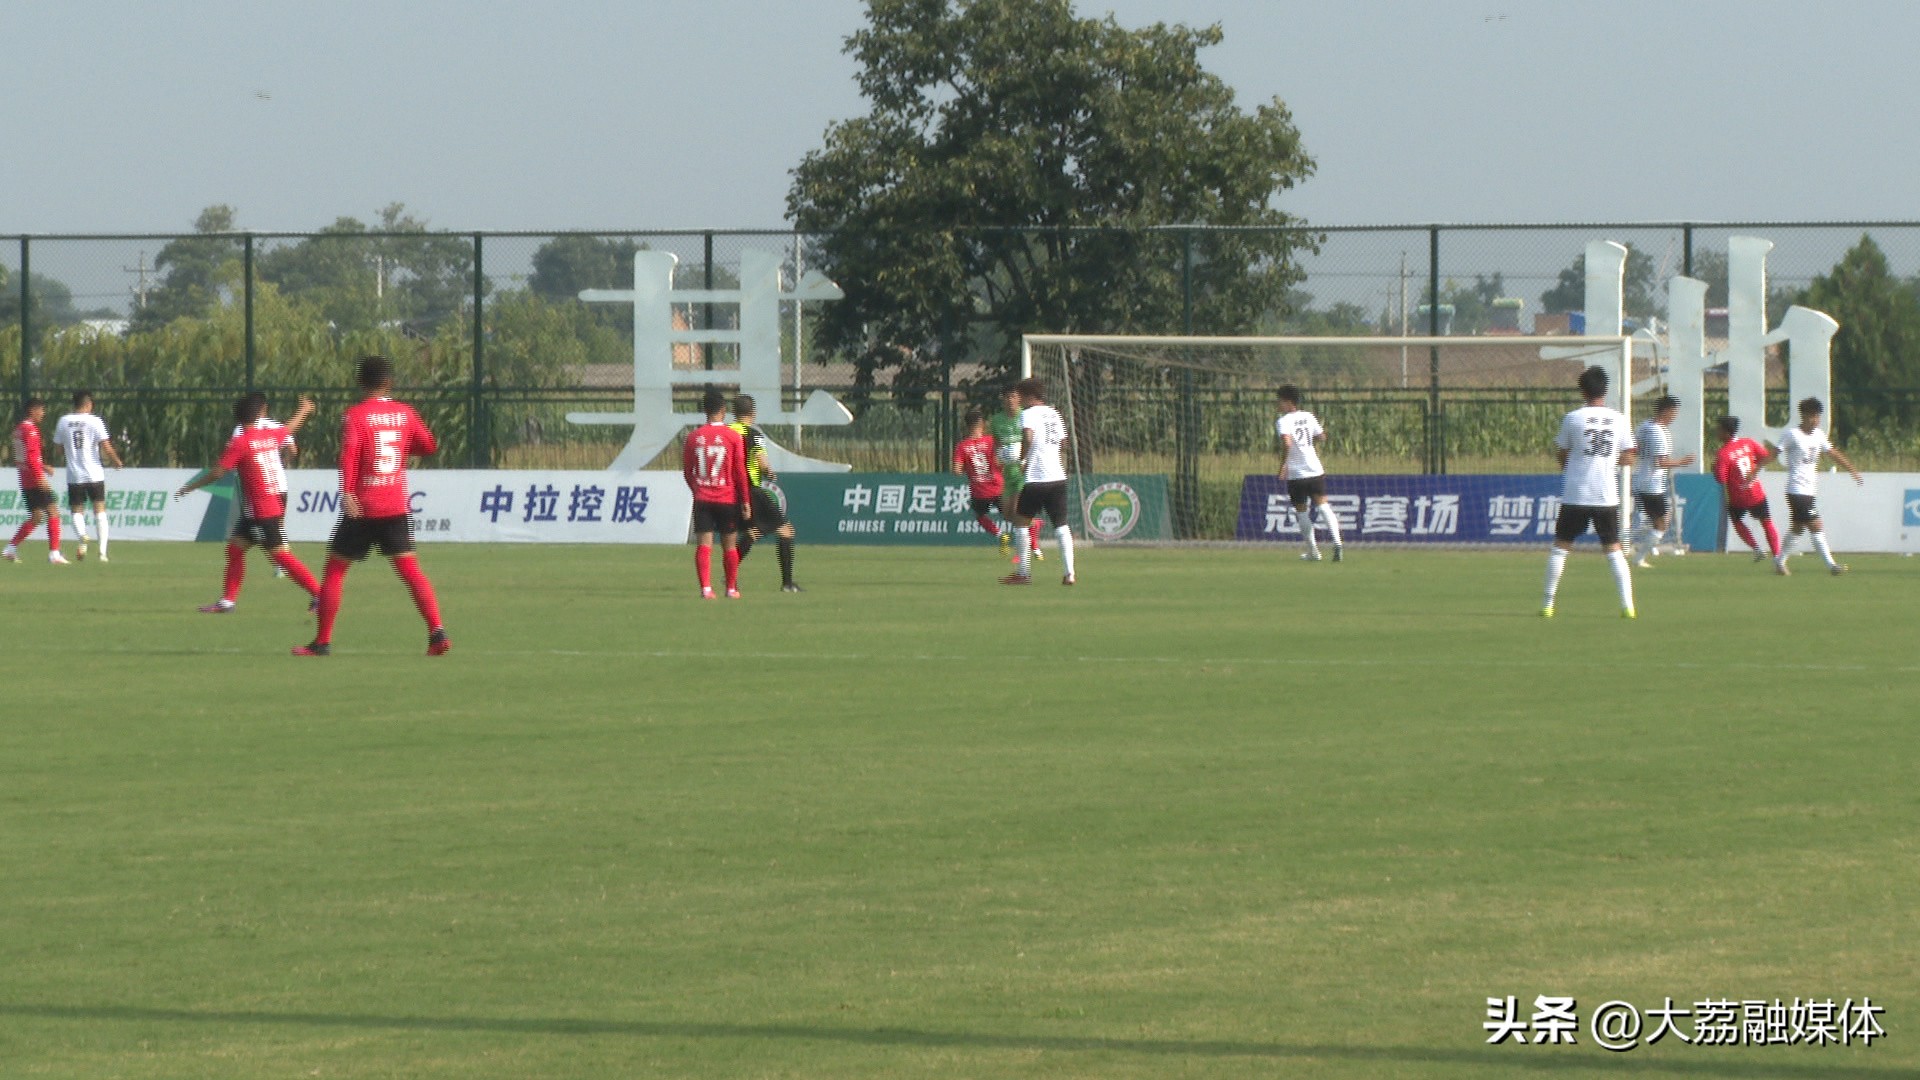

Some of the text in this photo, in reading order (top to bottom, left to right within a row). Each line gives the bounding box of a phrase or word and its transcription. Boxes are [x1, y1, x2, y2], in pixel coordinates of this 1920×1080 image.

[374, 430, 402, 475] 5
[1294, 428, 1312, 448] 21
[1583, 427, 1615, 459] 36
[693, 445, 727, 480] 17
[138, 514, 164, 527] MAY
[479, 485, 650, 524] 中拉控股
[1264, 493, 1460, 535] 冠军赛场
[837, 519, 886, 534] CHINESE
[893, 519, 949, 534] FOOTBALL
